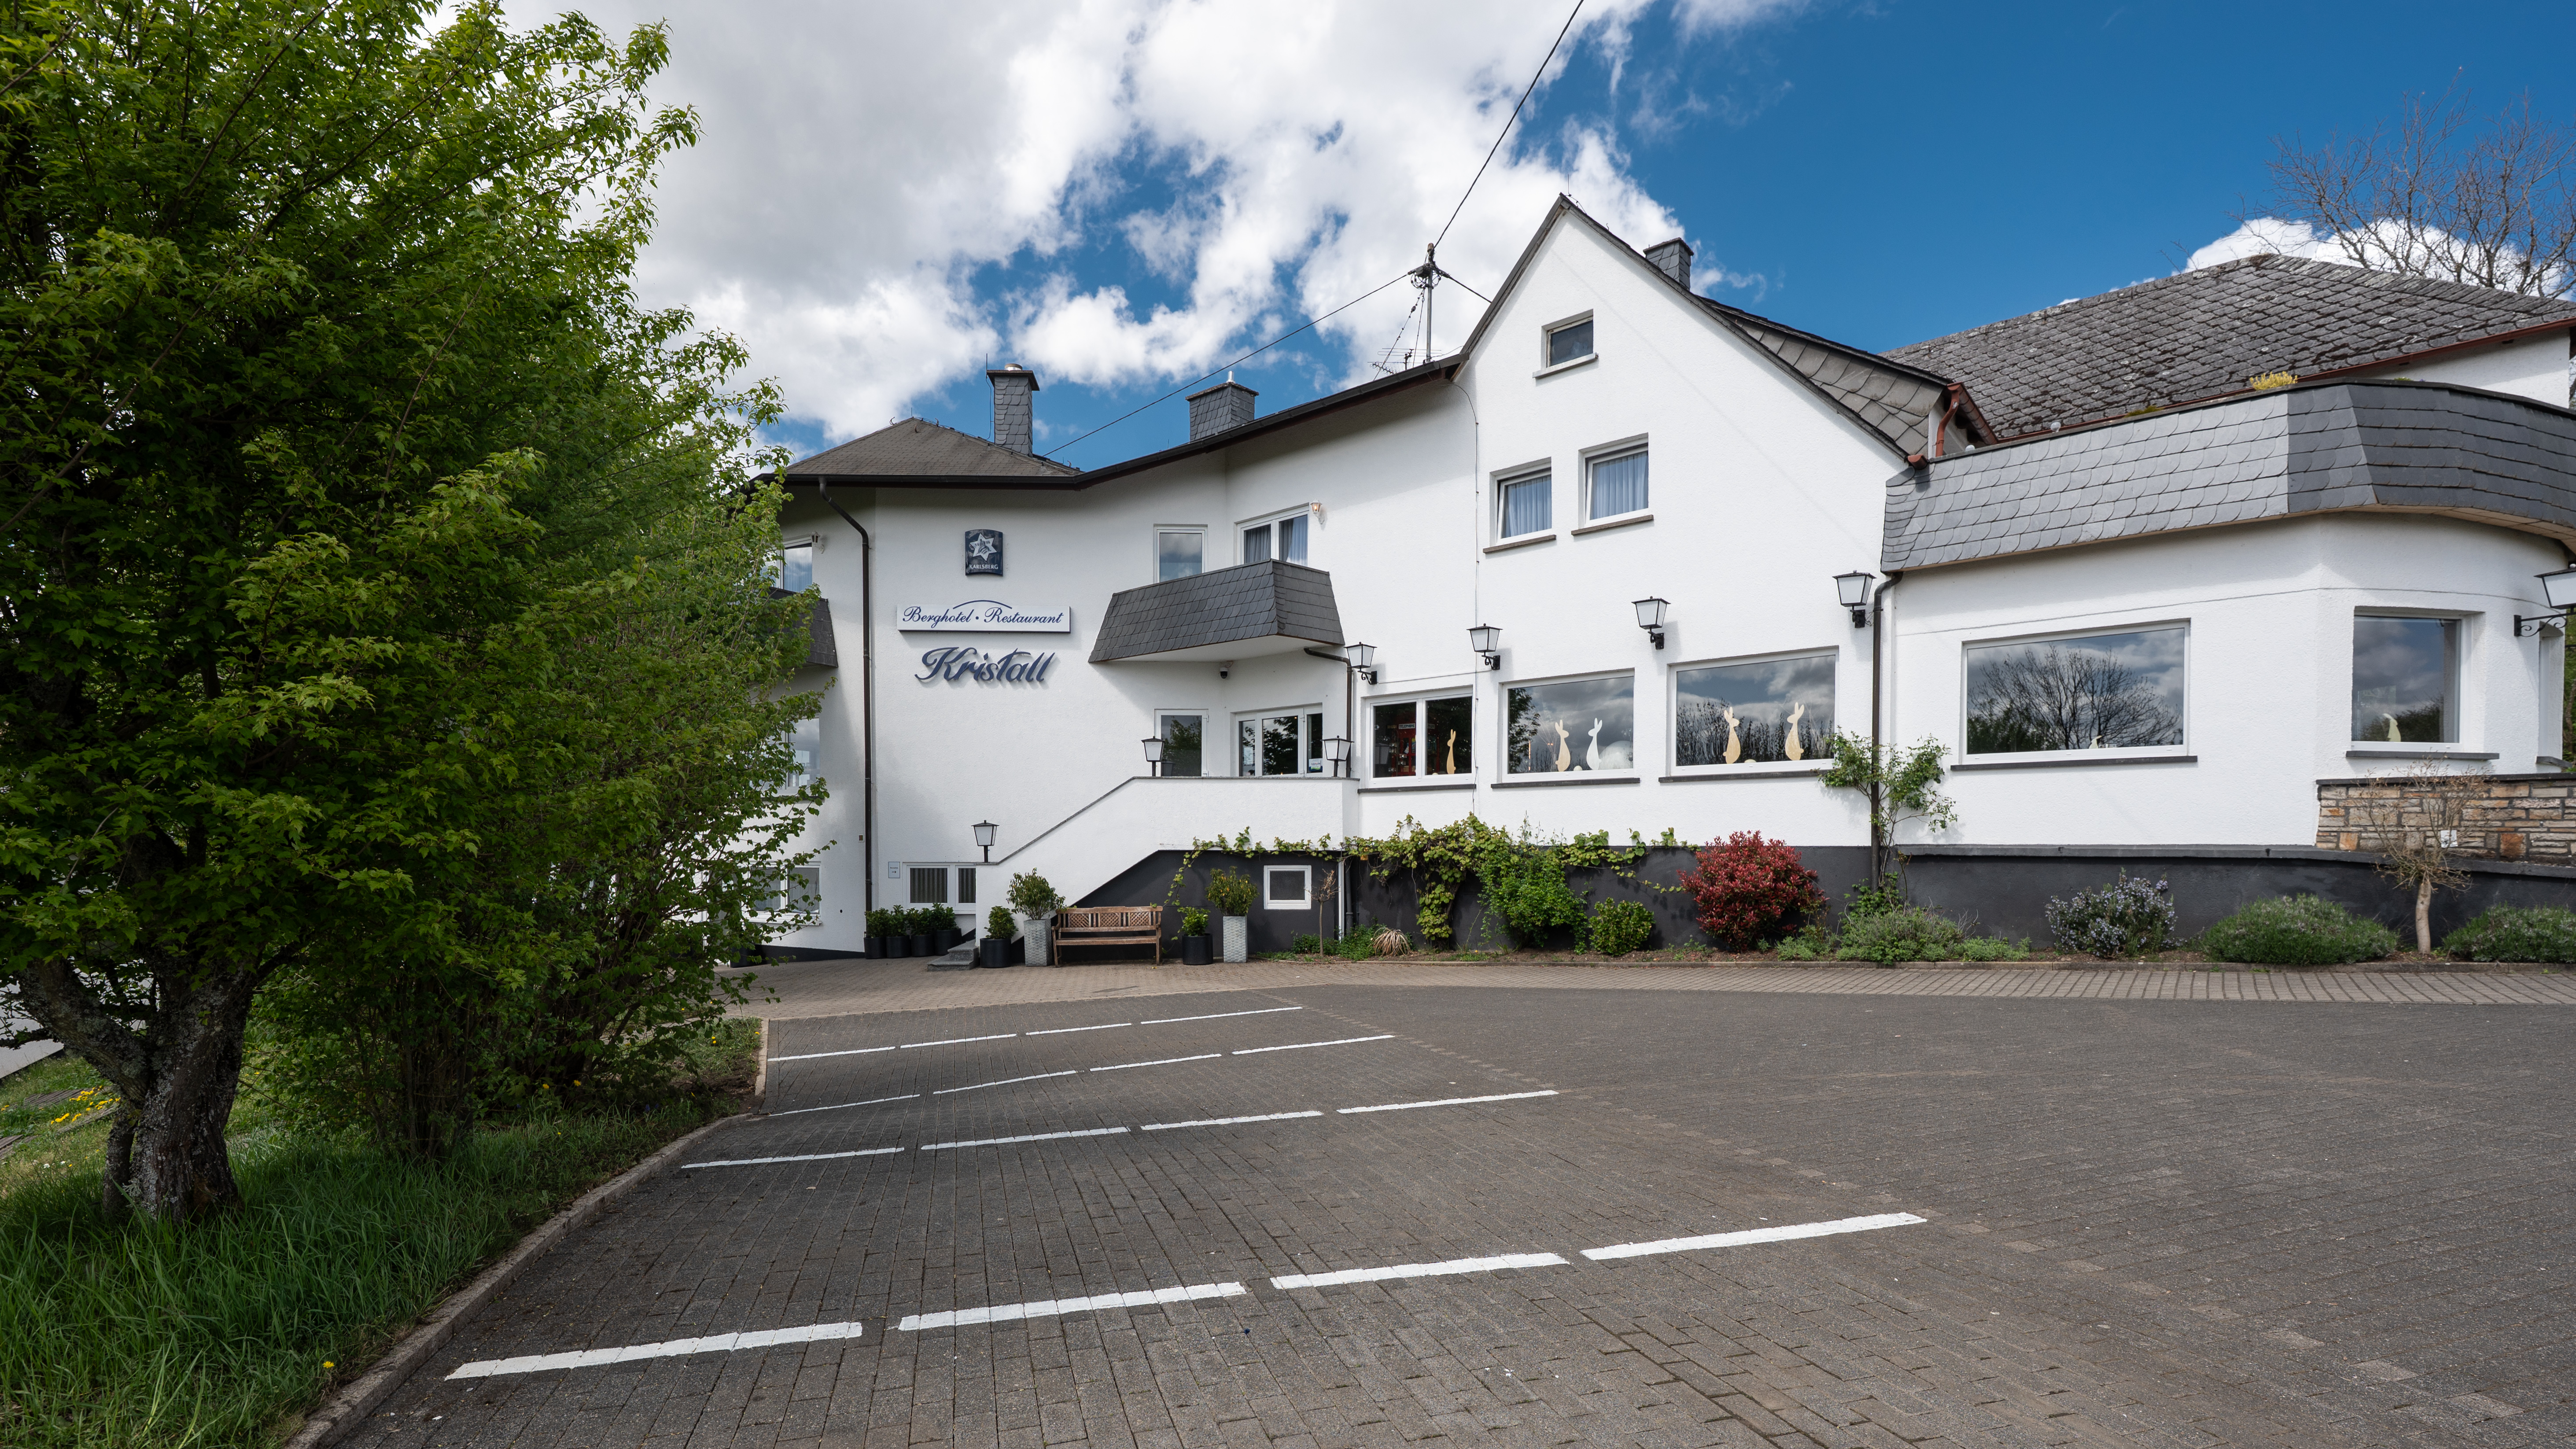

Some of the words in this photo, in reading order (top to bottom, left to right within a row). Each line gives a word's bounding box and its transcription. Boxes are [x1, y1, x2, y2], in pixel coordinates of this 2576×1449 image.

[903, 606, 974, 628] Berghotel
[984, 607, 1064, 623] Restaurant
[914, 647, 1055, 682] Kristall
